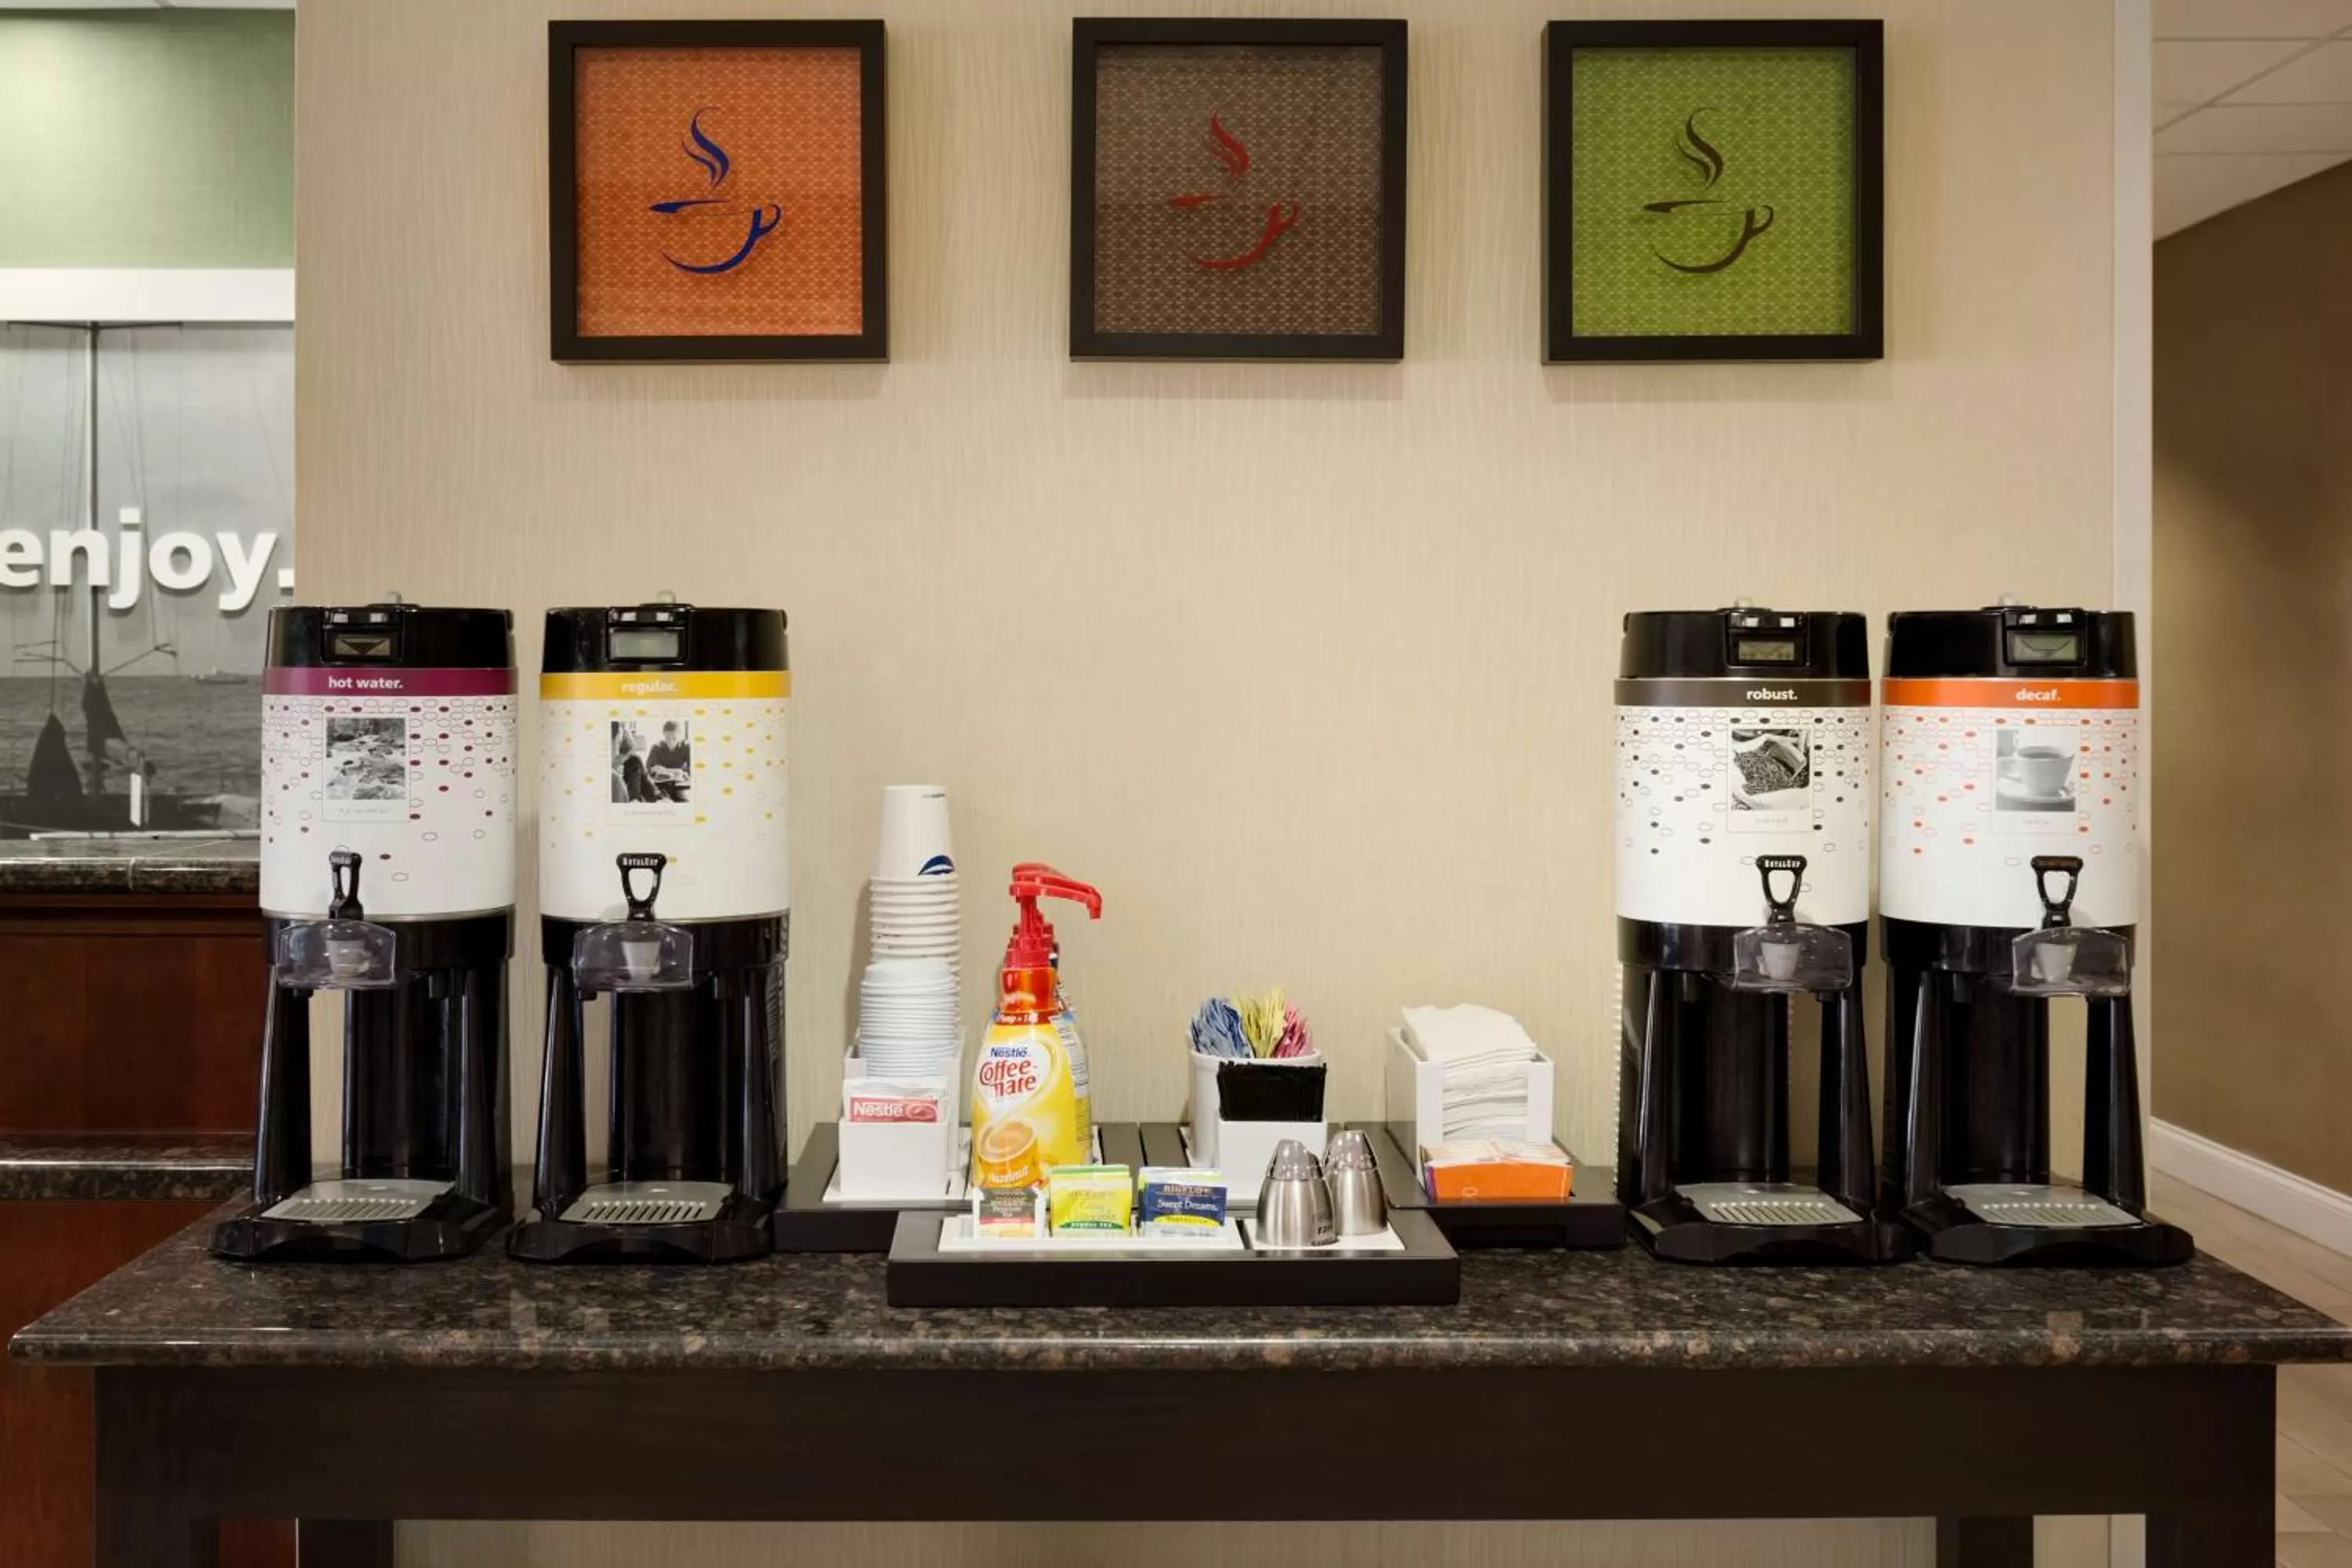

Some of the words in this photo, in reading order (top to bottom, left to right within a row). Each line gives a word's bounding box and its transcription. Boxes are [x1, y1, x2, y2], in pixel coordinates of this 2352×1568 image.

[0, 507, 295, 611] enjoy.
[328, 676, 353, 689] hot
[356, 677, 404, 689] water.
[621, 681, 678, 696] regular.
[1746, 688, 1798, 701] robust.
[2015, 688, 2062, 702] decaf.
